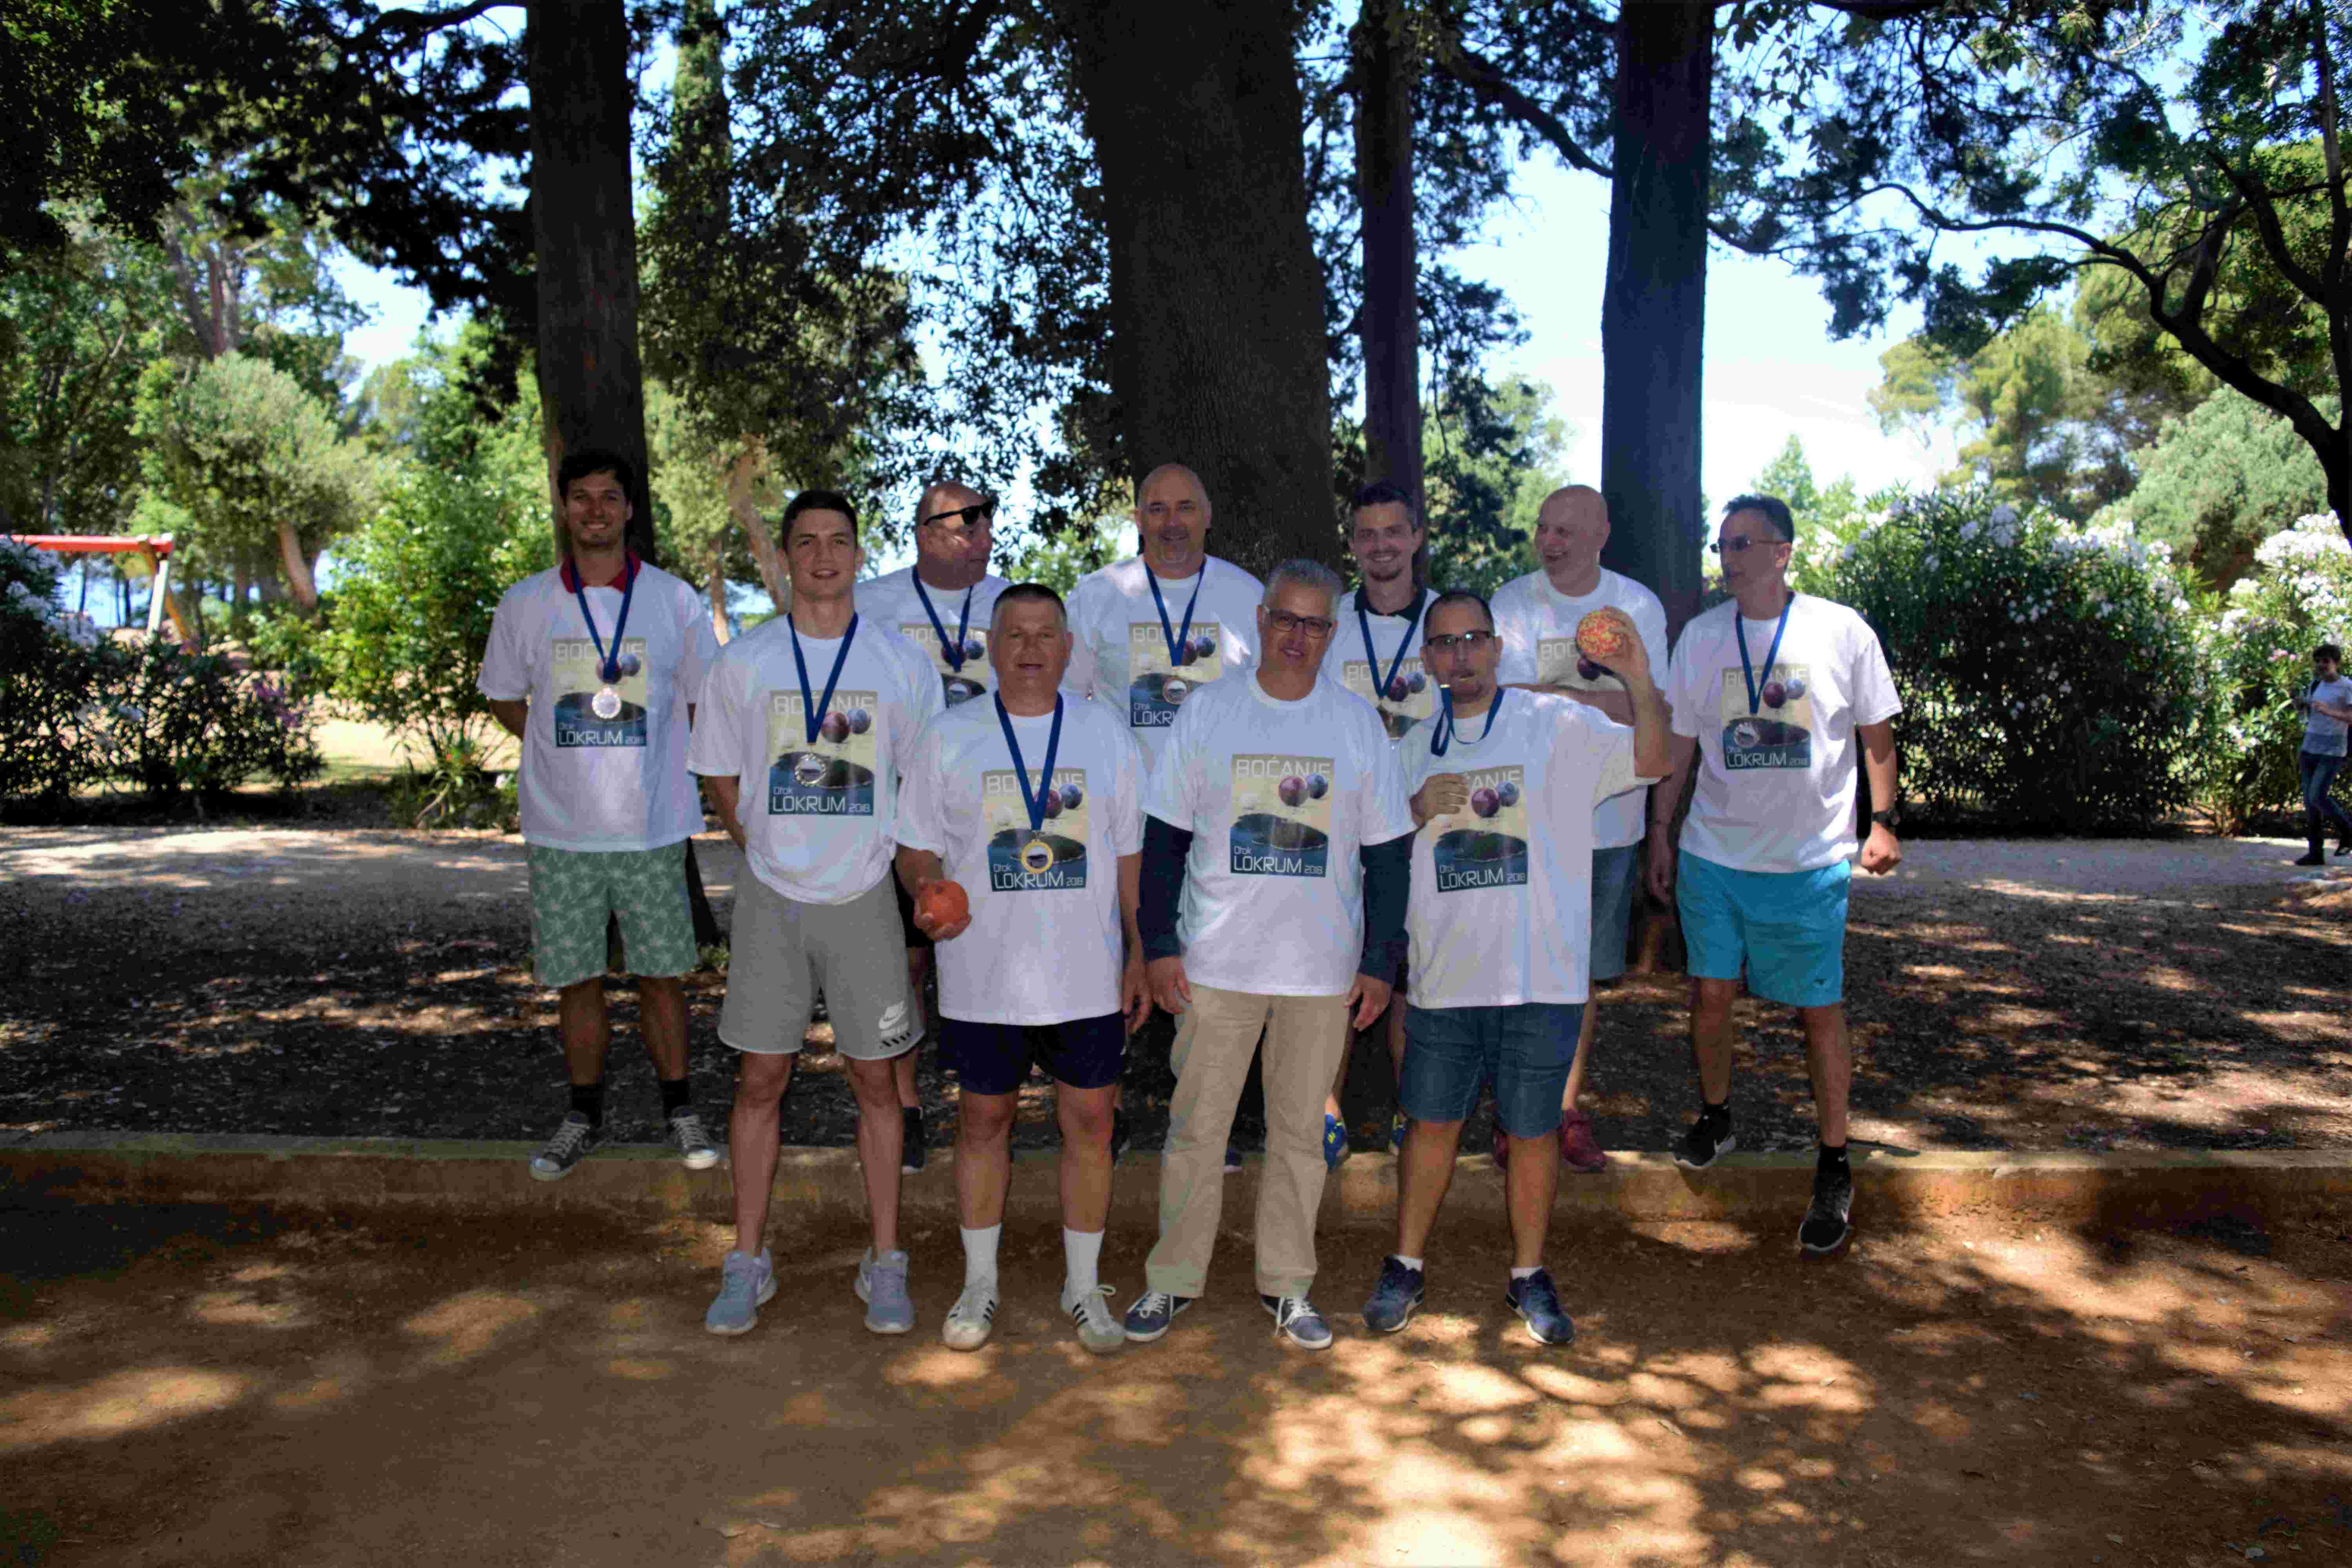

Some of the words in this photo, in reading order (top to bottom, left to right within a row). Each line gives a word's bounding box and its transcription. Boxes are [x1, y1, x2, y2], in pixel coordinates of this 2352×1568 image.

[559, 730, 622, 745] LOKRUM
[1726, 752, 1787, 767] LOKRUM
[773, 796, 845, 812] LOKRUM
[1234, 855, 1302, 873] LOKRUM
[994, 871, 1063, 889] LOKRUM
[1066, 877, 1083, 886] 2018
[1440, 867, 1504, 889] LOKRUM
